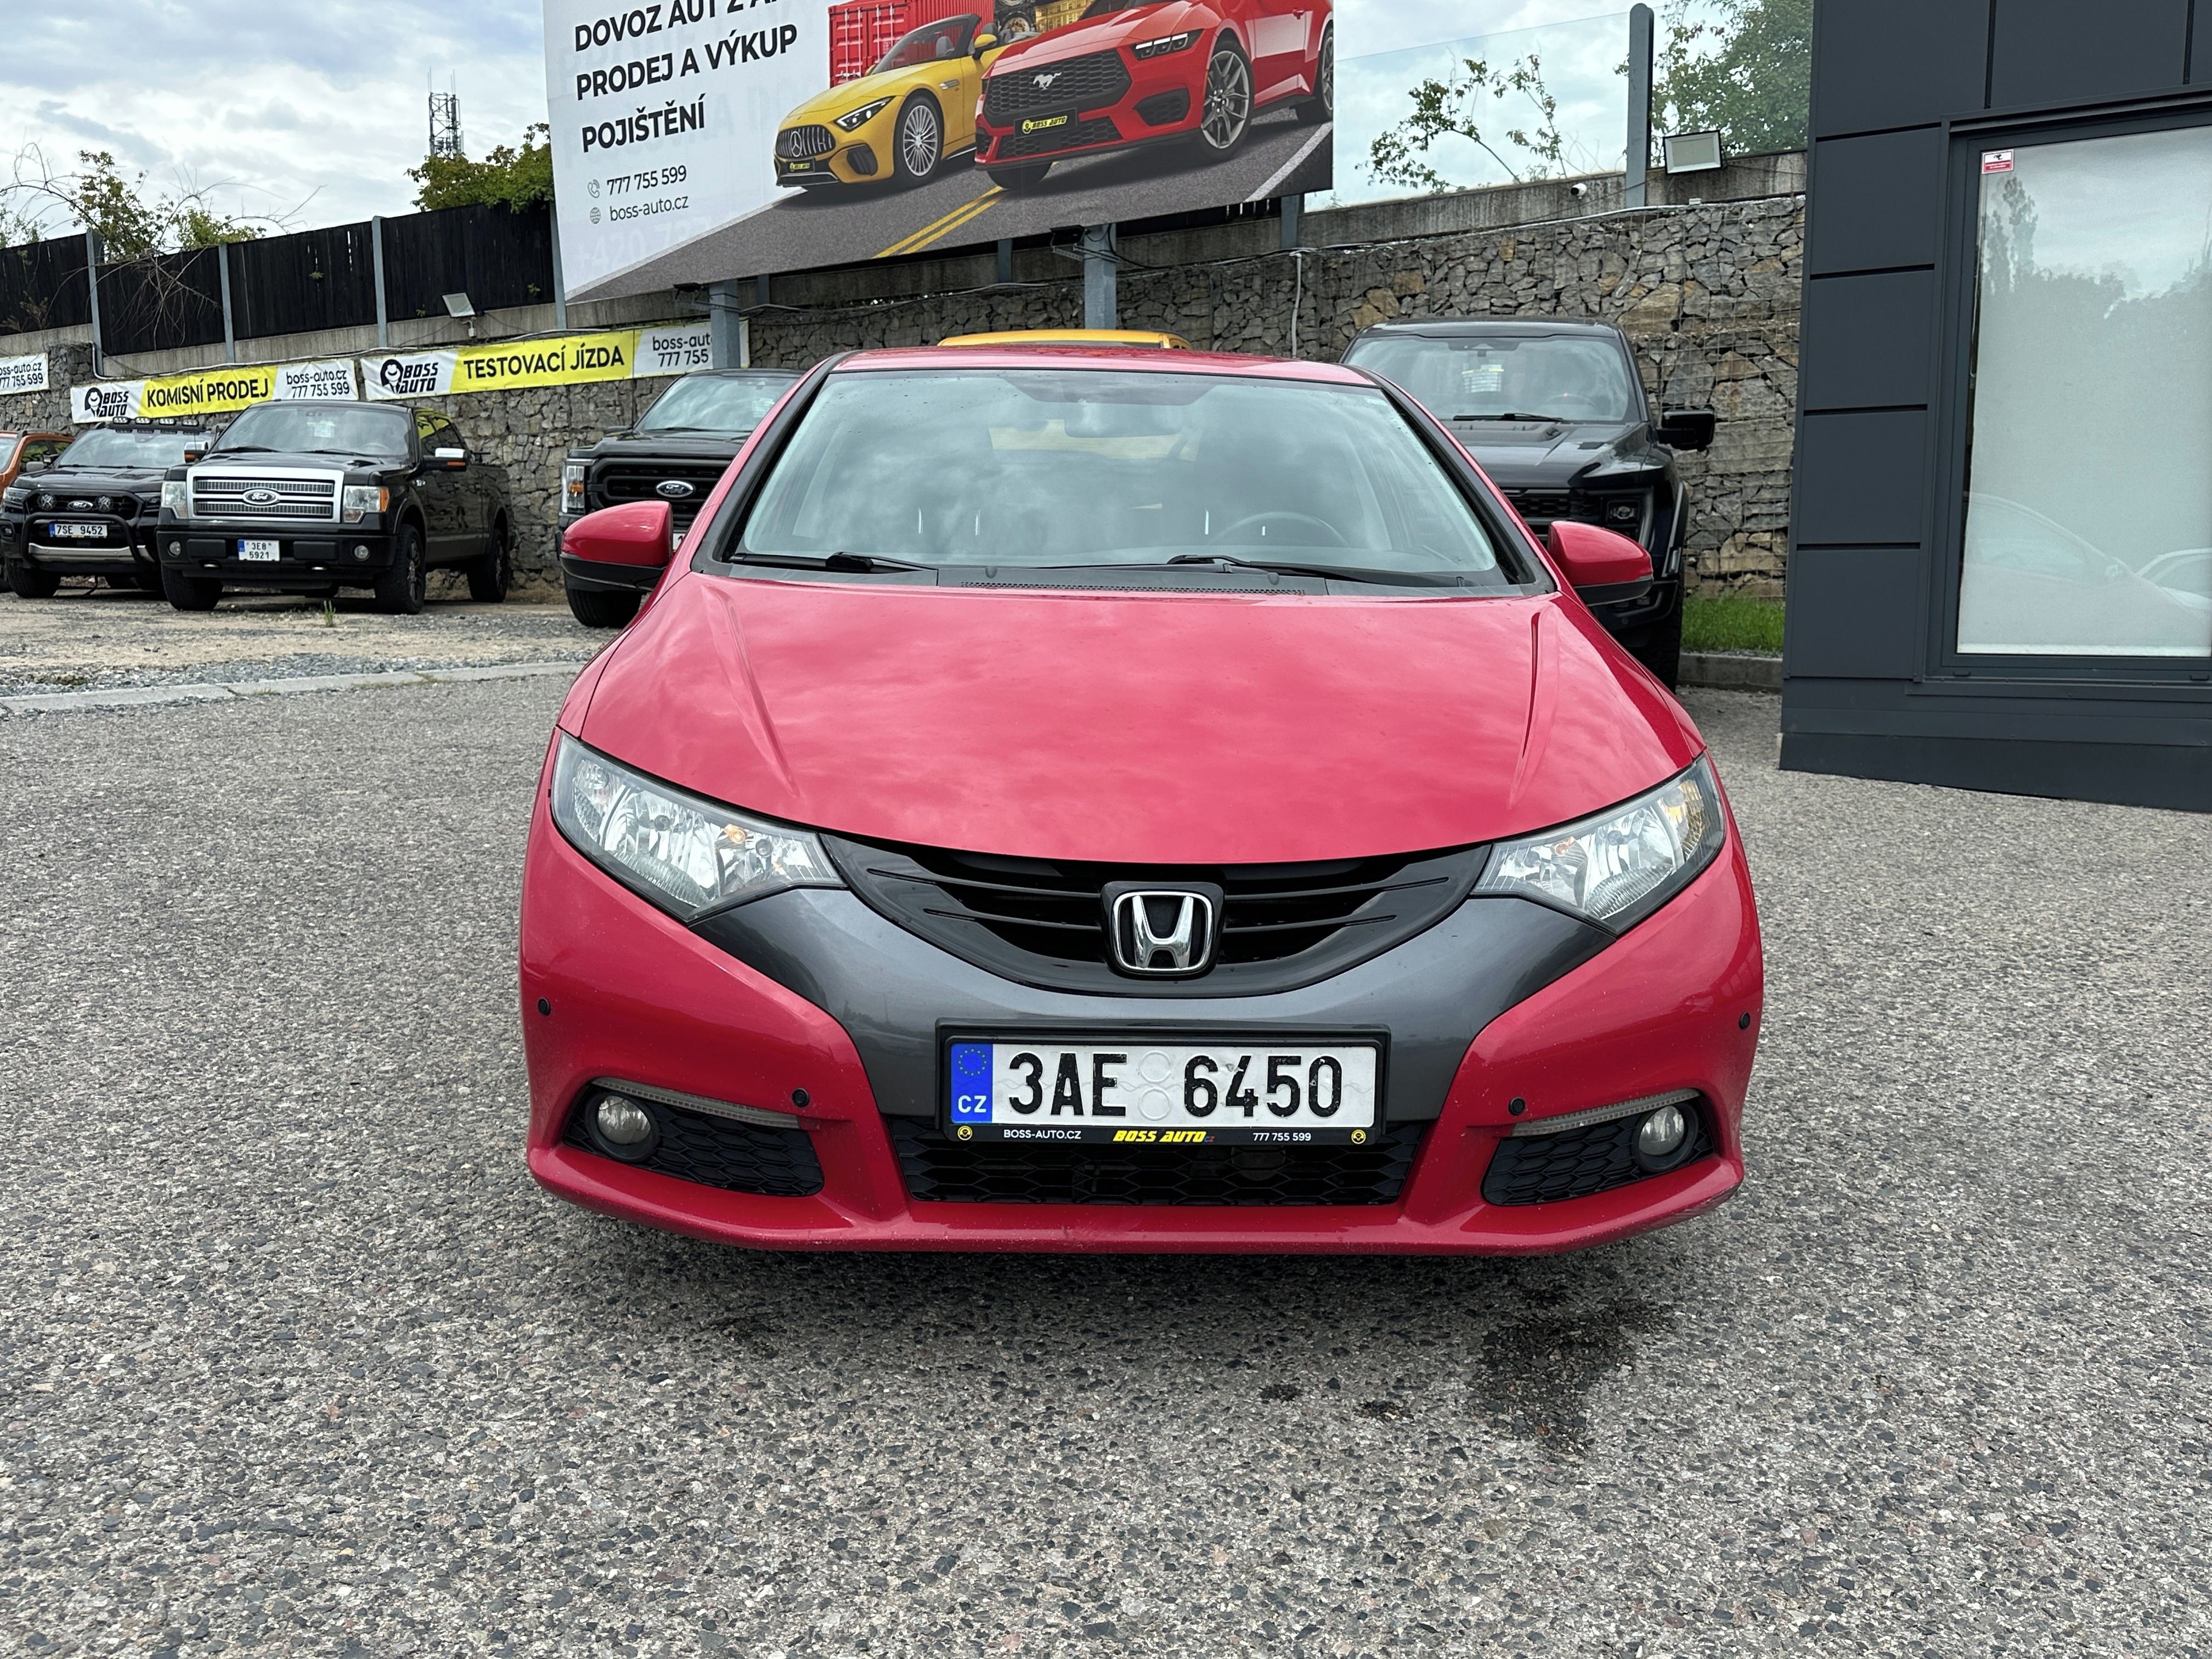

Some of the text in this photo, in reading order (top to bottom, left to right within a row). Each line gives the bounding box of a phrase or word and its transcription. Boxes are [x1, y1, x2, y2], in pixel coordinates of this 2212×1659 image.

[575, 4, 662, 52] DOVOZ
[576, 24, 797, 101] PRODEJ A VÝKUP
[582, 93, 707, 153] POJIŠTĚNÍ
[607, 165, 686, 196] 777 755 599
[610, 196, 689, 221] boss-auto.cz
[653, 333, 712, 351] boss-aut
[463, 342, 625, 380] TESTOVACÍ JÍZDA
[658, 349, 709, 367] 777 755
[286, 370, 347, 385] boss-auto.cz
[403, 362, 438, 378] BOSS
[12, 375, 26, 387] 755
[27, 373, 43, 385] 599
[399, 377, 436, 394] AUTO
[103, 391, 129, 404] BOSS
[147, 378, 269, 408] KOMISNÍ PRODEJ
[292, 381, 349, 398] 777 755 599
[98, 404, 127, 417] AUTO
[57, 525, 74, 534] 7SE
[80, 526, 103, 535] 9452
[249, 551, 269, 559] 5921
[1008, 1052, 1342, 1118] 3AE 6450
[958, 1096, 987, 1113] CZ
[1003, 1129, 1081, 1139] BOSS-AUTO.CZ
[1113, 1130, 1156, 1142] BOSS
[1159, 1131, 1207, 1143] AUTO
[1252, 1132, 1311, 1141] 777 755 599
